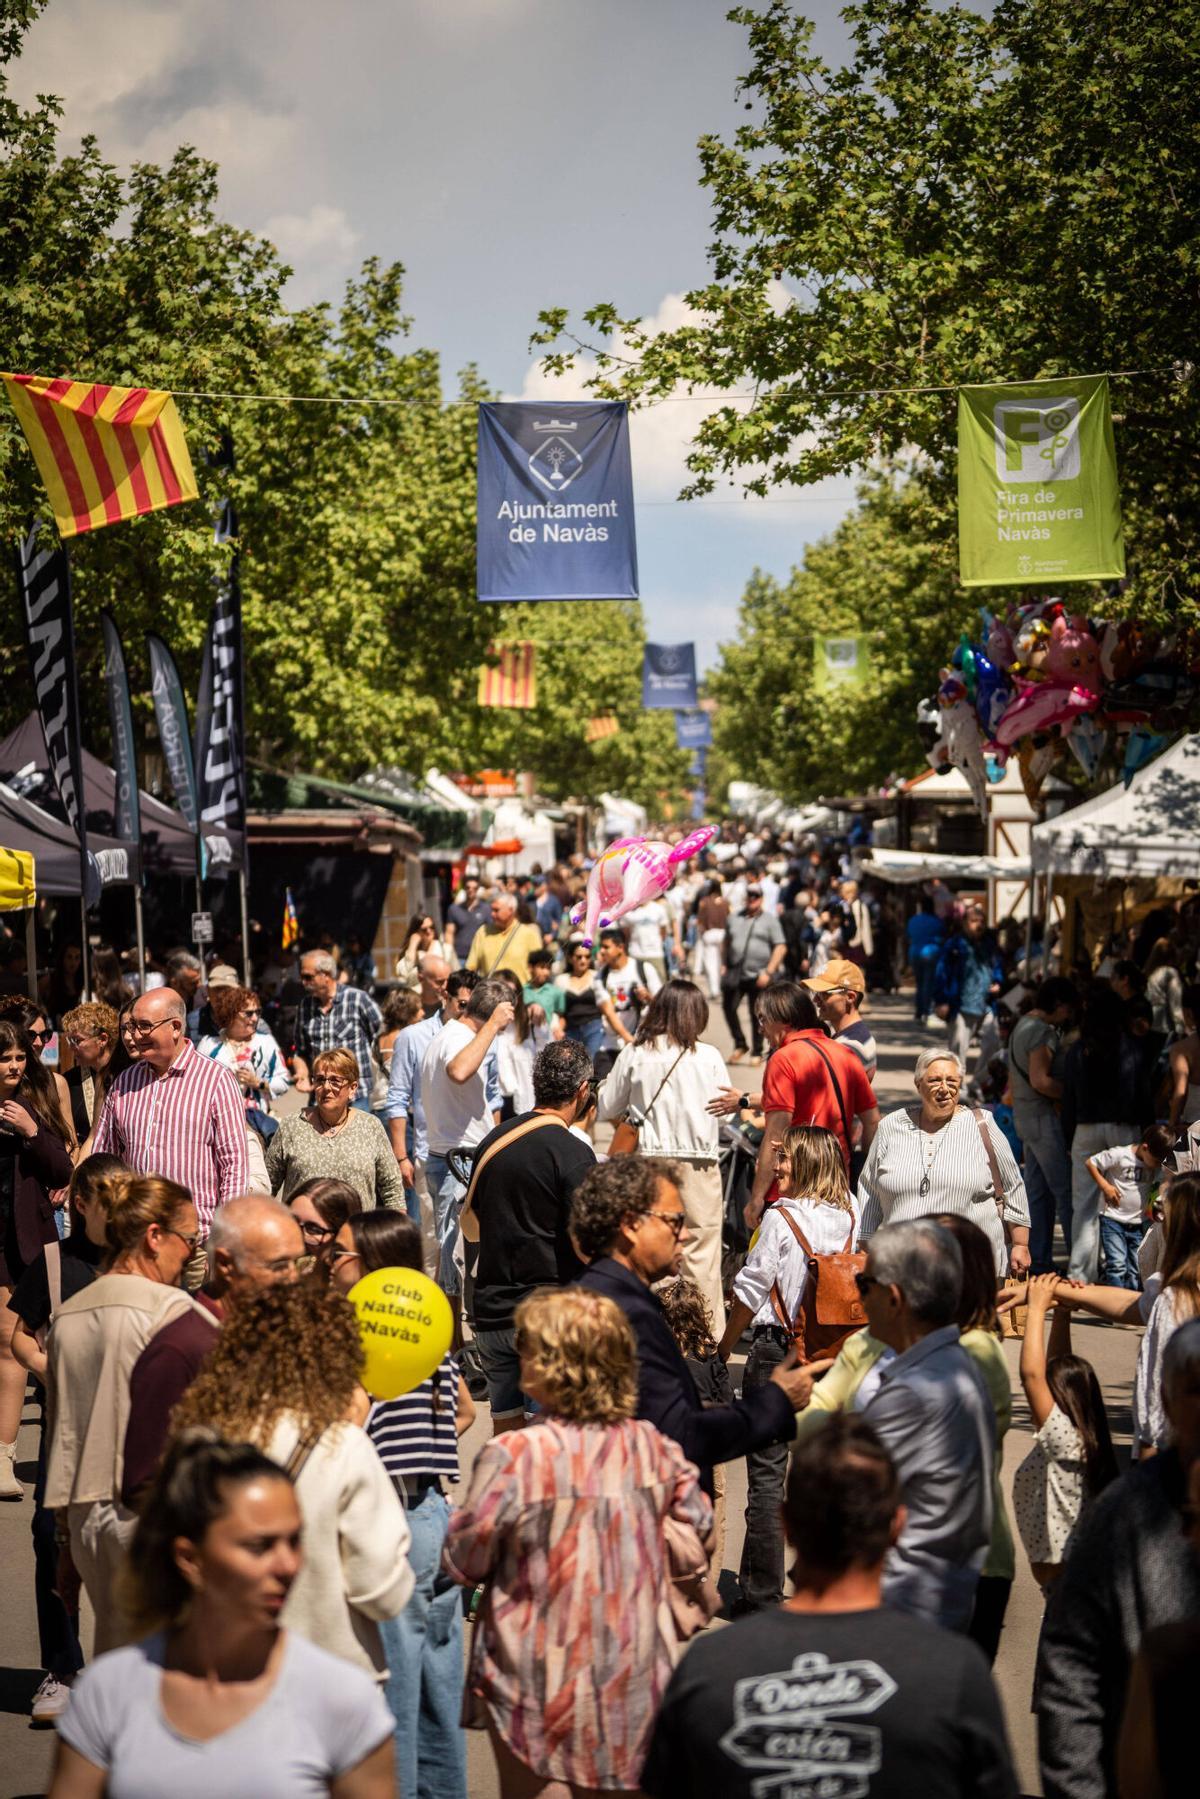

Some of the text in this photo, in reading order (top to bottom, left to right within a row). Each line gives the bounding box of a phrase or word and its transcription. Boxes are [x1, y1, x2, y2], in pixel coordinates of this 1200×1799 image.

[996, 489, 1056, 505] Fira de
[497, 500, 618, 524] Ajuntament
[997, 507, 1084, 523] Primavera
[509, 523, 609, 543] de Navàs
[997, 525, 1051, 541] Navàs
[382, 1283, 423, 1303] Club
[363, 1300, 432, 1326] Natació
[754, 1671, 864, 1713] Donde
